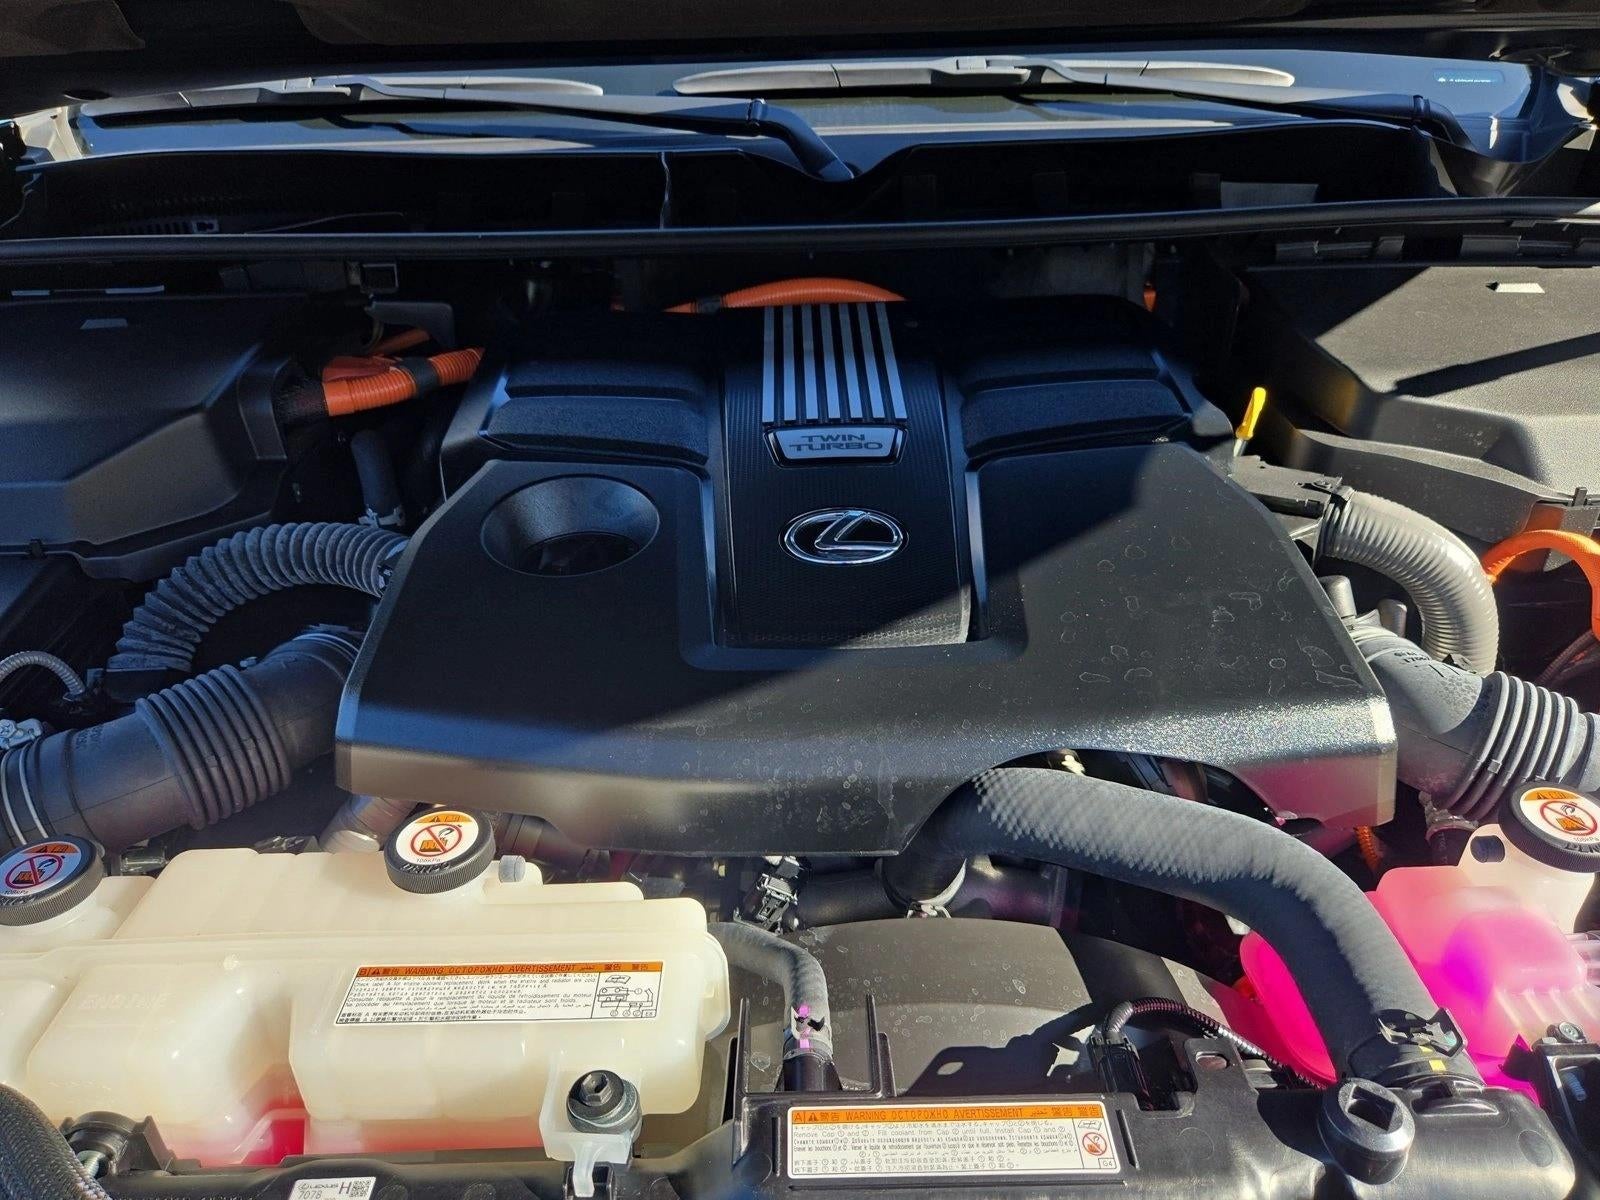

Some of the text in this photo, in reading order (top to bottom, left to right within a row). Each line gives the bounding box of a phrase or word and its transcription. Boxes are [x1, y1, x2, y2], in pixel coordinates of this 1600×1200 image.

[801, 433, 866, 443] TWIN
[789, 441, 884, 452] TURBO
[404, 966, 445, 975] WARNING
[509, 964, 575, 973] AVERTISSEMENT
[794, 1112, 803, 1122] A
[845, 1110, 886, 1121] WARNING
[953, 1107, 1023, 1119] AVERTISSEMENT
[339, 1181, 353, 1194] H
